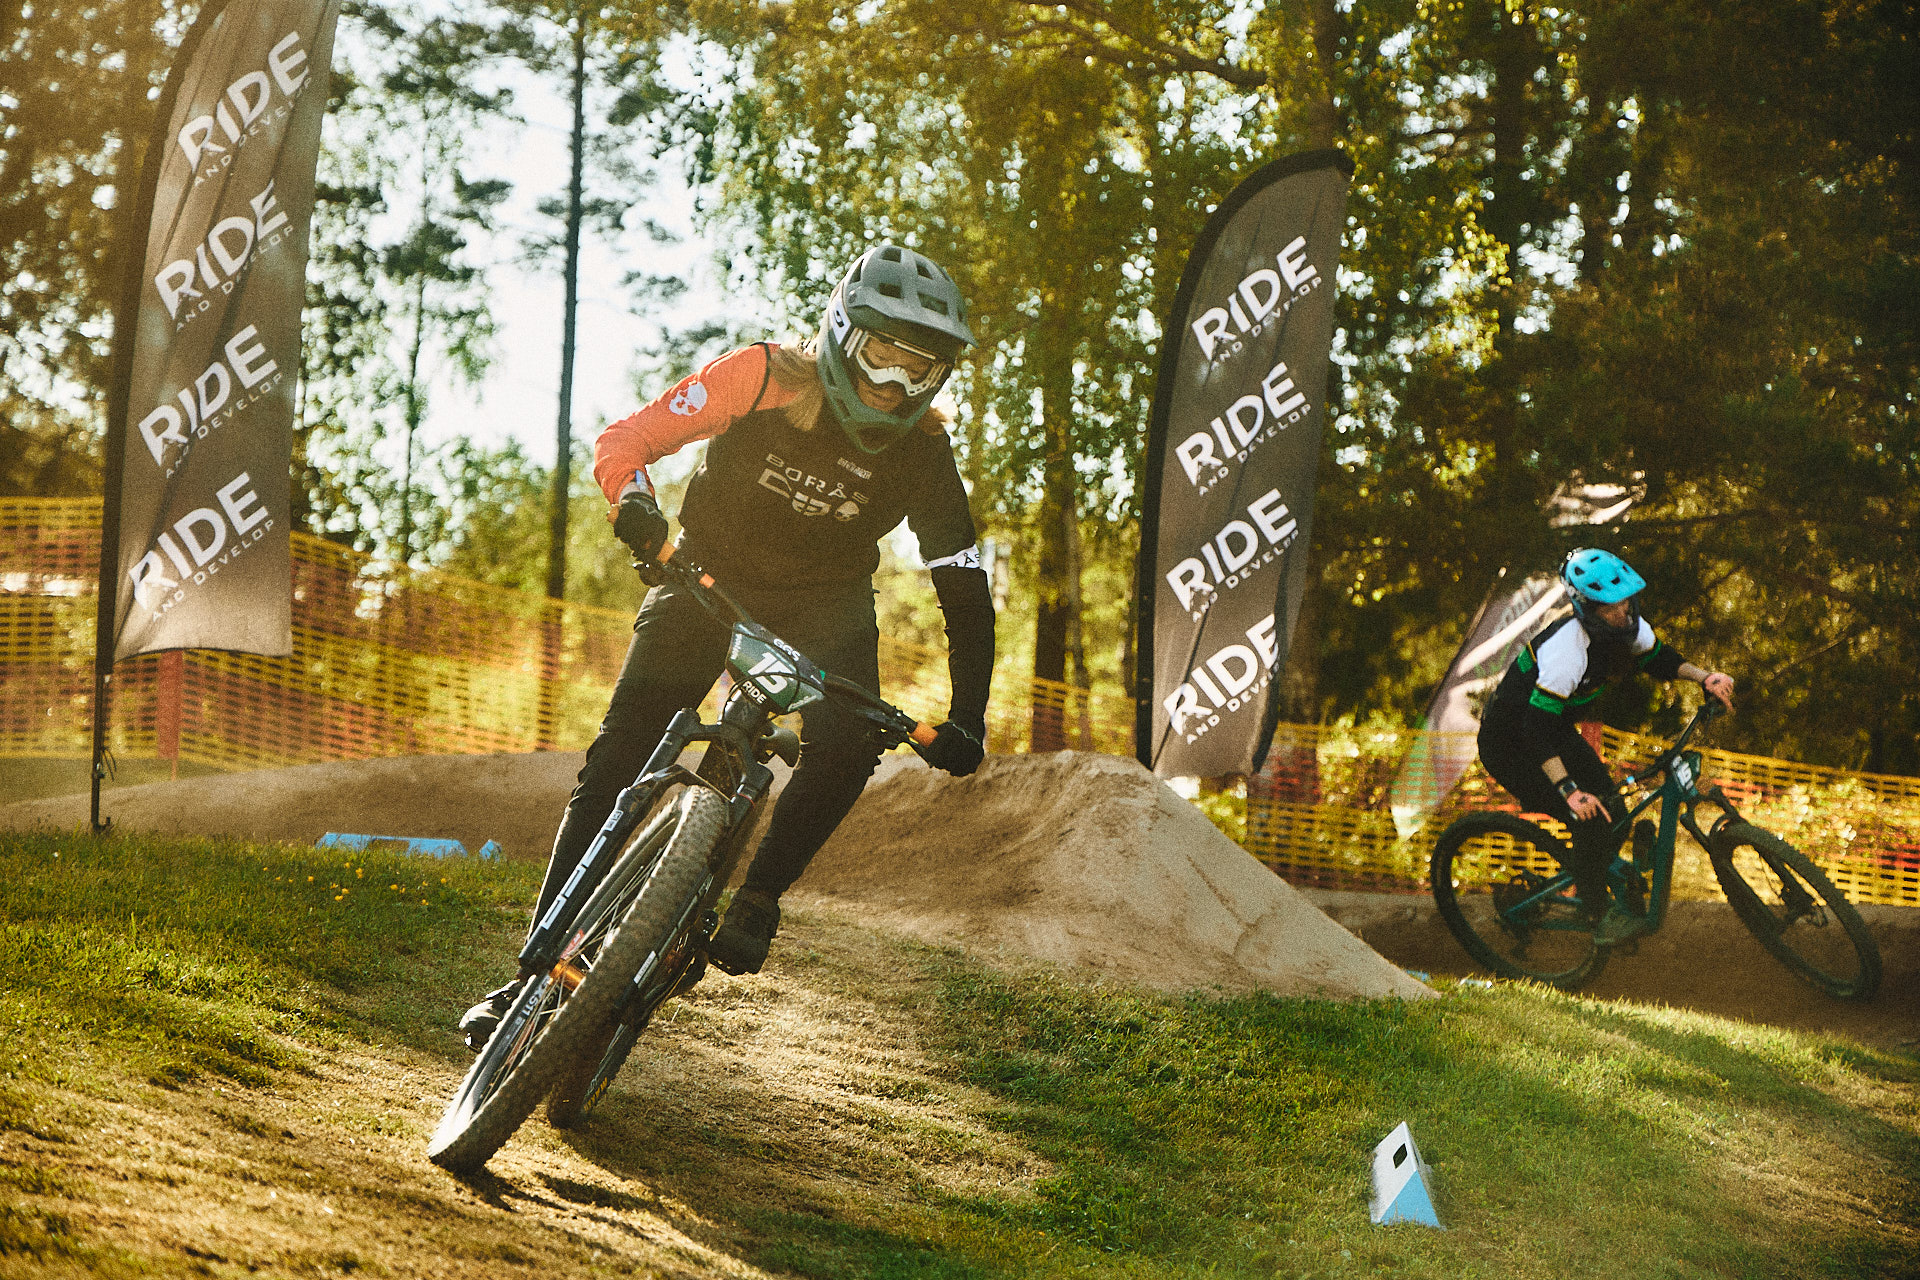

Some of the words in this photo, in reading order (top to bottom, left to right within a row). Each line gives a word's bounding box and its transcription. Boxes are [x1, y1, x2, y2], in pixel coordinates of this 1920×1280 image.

[178, 31, 309, 174] RIDE
[194, 154, 232, 187] AND
[155, 178, 289, 320] RIDE
[1191, 235, 1318, 361] RIDE
[177, 300, 210, 332] AND
[138, 324, 278, 467] RIDE
[196, 372, 282, 440] DEVELOP
[1175, 361, 1307, 487] RIDE
[1199, 466, 1230, 496] AND
[128, 472, 269, 611] RIDE
[152, 589, 185, 623] AND
[193, 518, 275, 586] DEVELOP
[1166, 488, 1297, 612] RIDE
[742, 681, 767, 704] RIDE
[747, 652, 796, 694] 15
[1163, 613, 1280, 736] RIDE
[1187, 715, 1221, 745] AND
